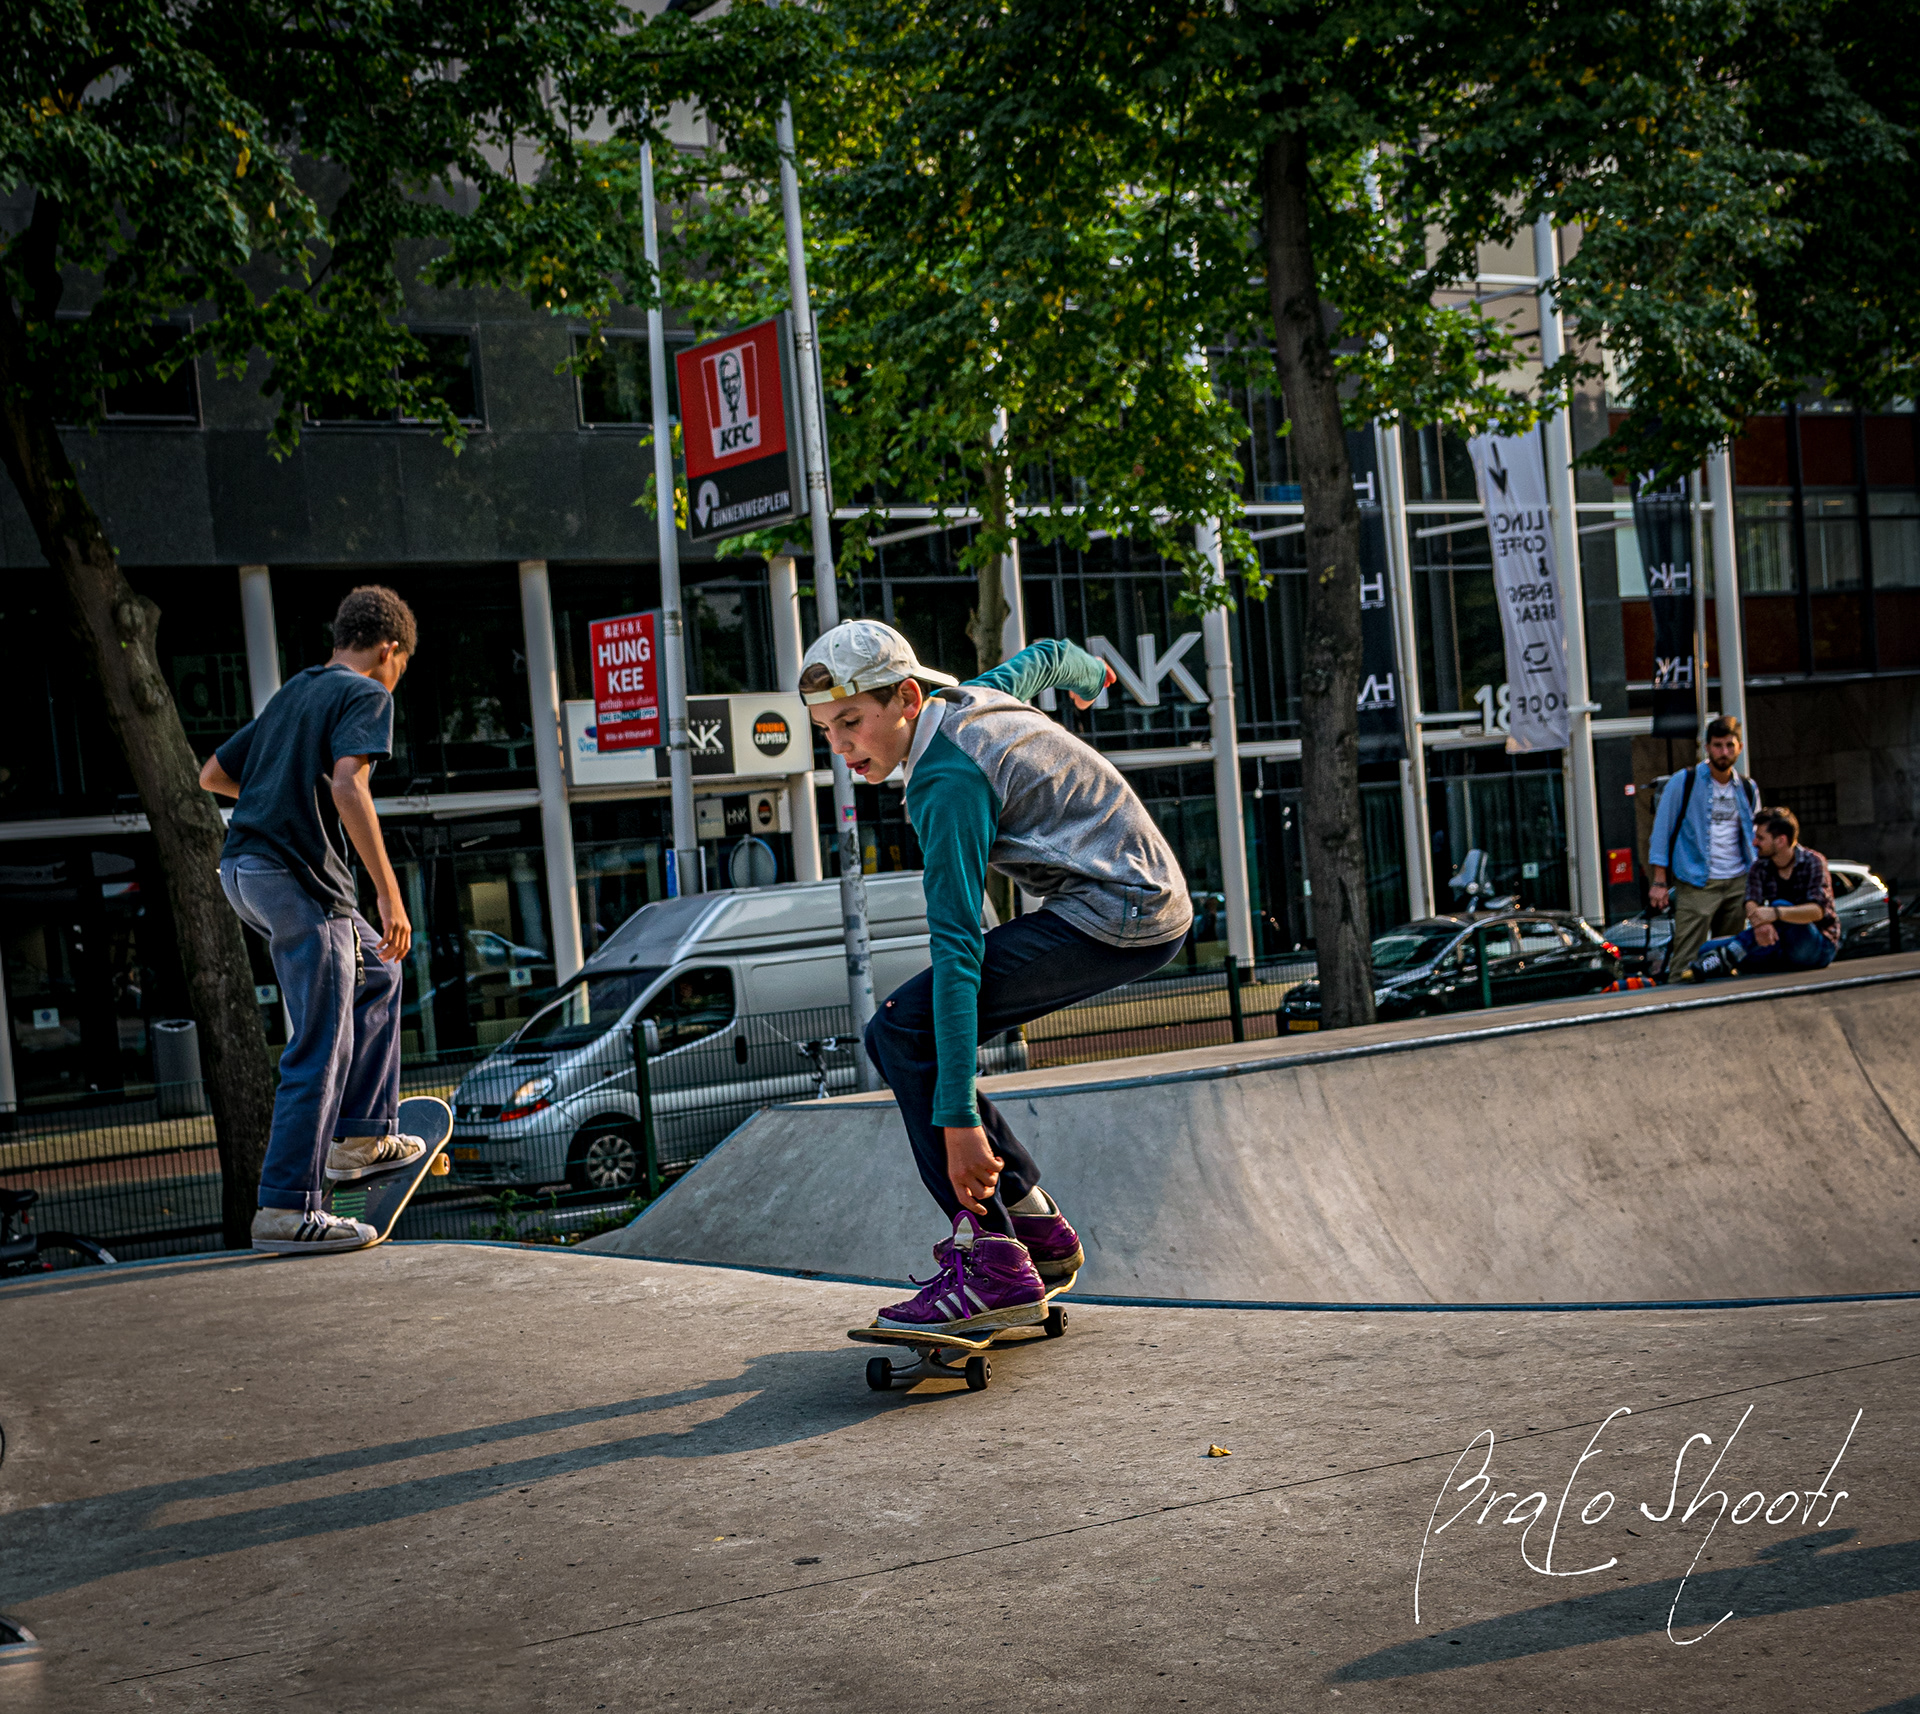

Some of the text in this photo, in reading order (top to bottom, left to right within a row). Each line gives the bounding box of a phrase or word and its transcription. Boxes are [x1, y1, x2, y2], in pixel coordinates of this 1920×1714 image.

[720, 422, 754, 452] KFC
[597, 636, 651, 668] HUNG
[608, 667, 645, 694] KEE
[1034, 631, 1211, 712] NK
[687, 724, 724, 750] NK
[754, 732, 788, 745] CAPITAL
[755, 722, 786, 733] YOUNG
